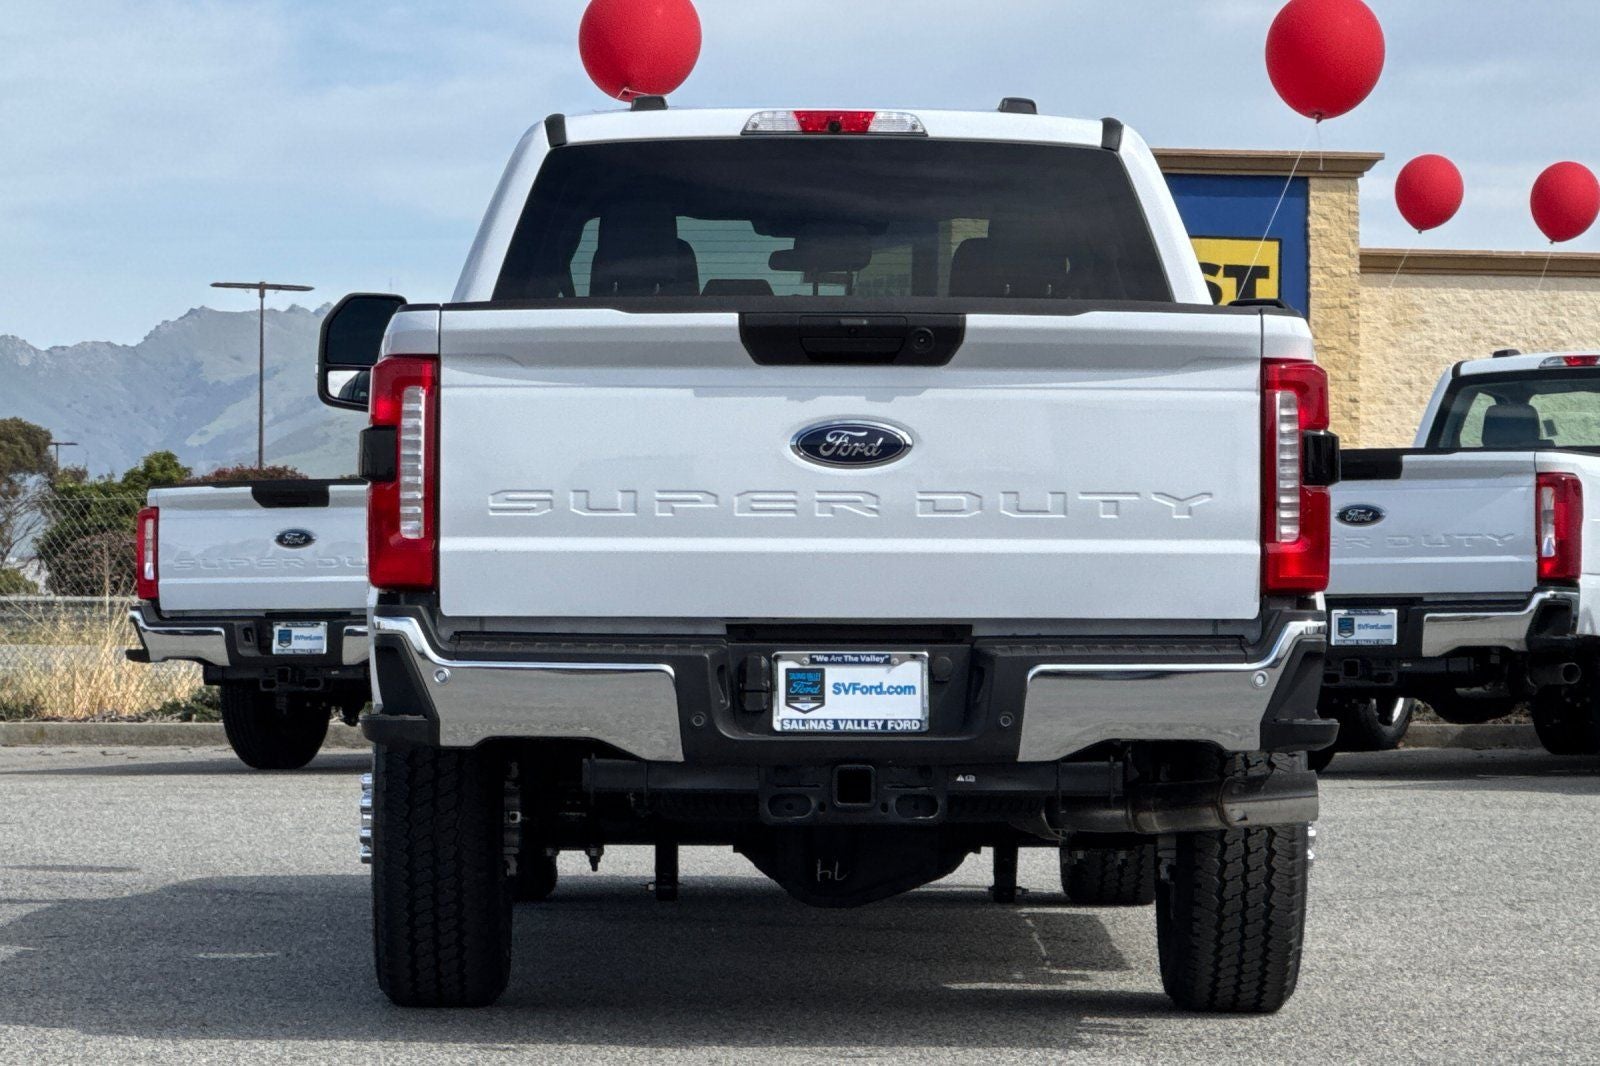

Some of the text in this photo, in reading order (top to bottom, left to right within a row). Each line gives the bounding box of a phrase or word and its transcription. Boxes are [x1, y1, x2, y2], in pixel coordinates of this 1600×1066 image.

[819, 429, 884, 457] Ford
[488, 489, 1213, 519] SUPER DUTY
[1345, 508, 1372, 522] Ford
[283, 532, 306, 545] Ford
[1385, 532, 1515, 549] DUTY
[173, 556, 305, 571] SUPER
[843, 654, 859, 662] The
[789, 681, 821, 695] Ford
[832, 681, 917, 696] SVFord.com
[782, 719, 921, 730] SALINAS VALLEY FORD
